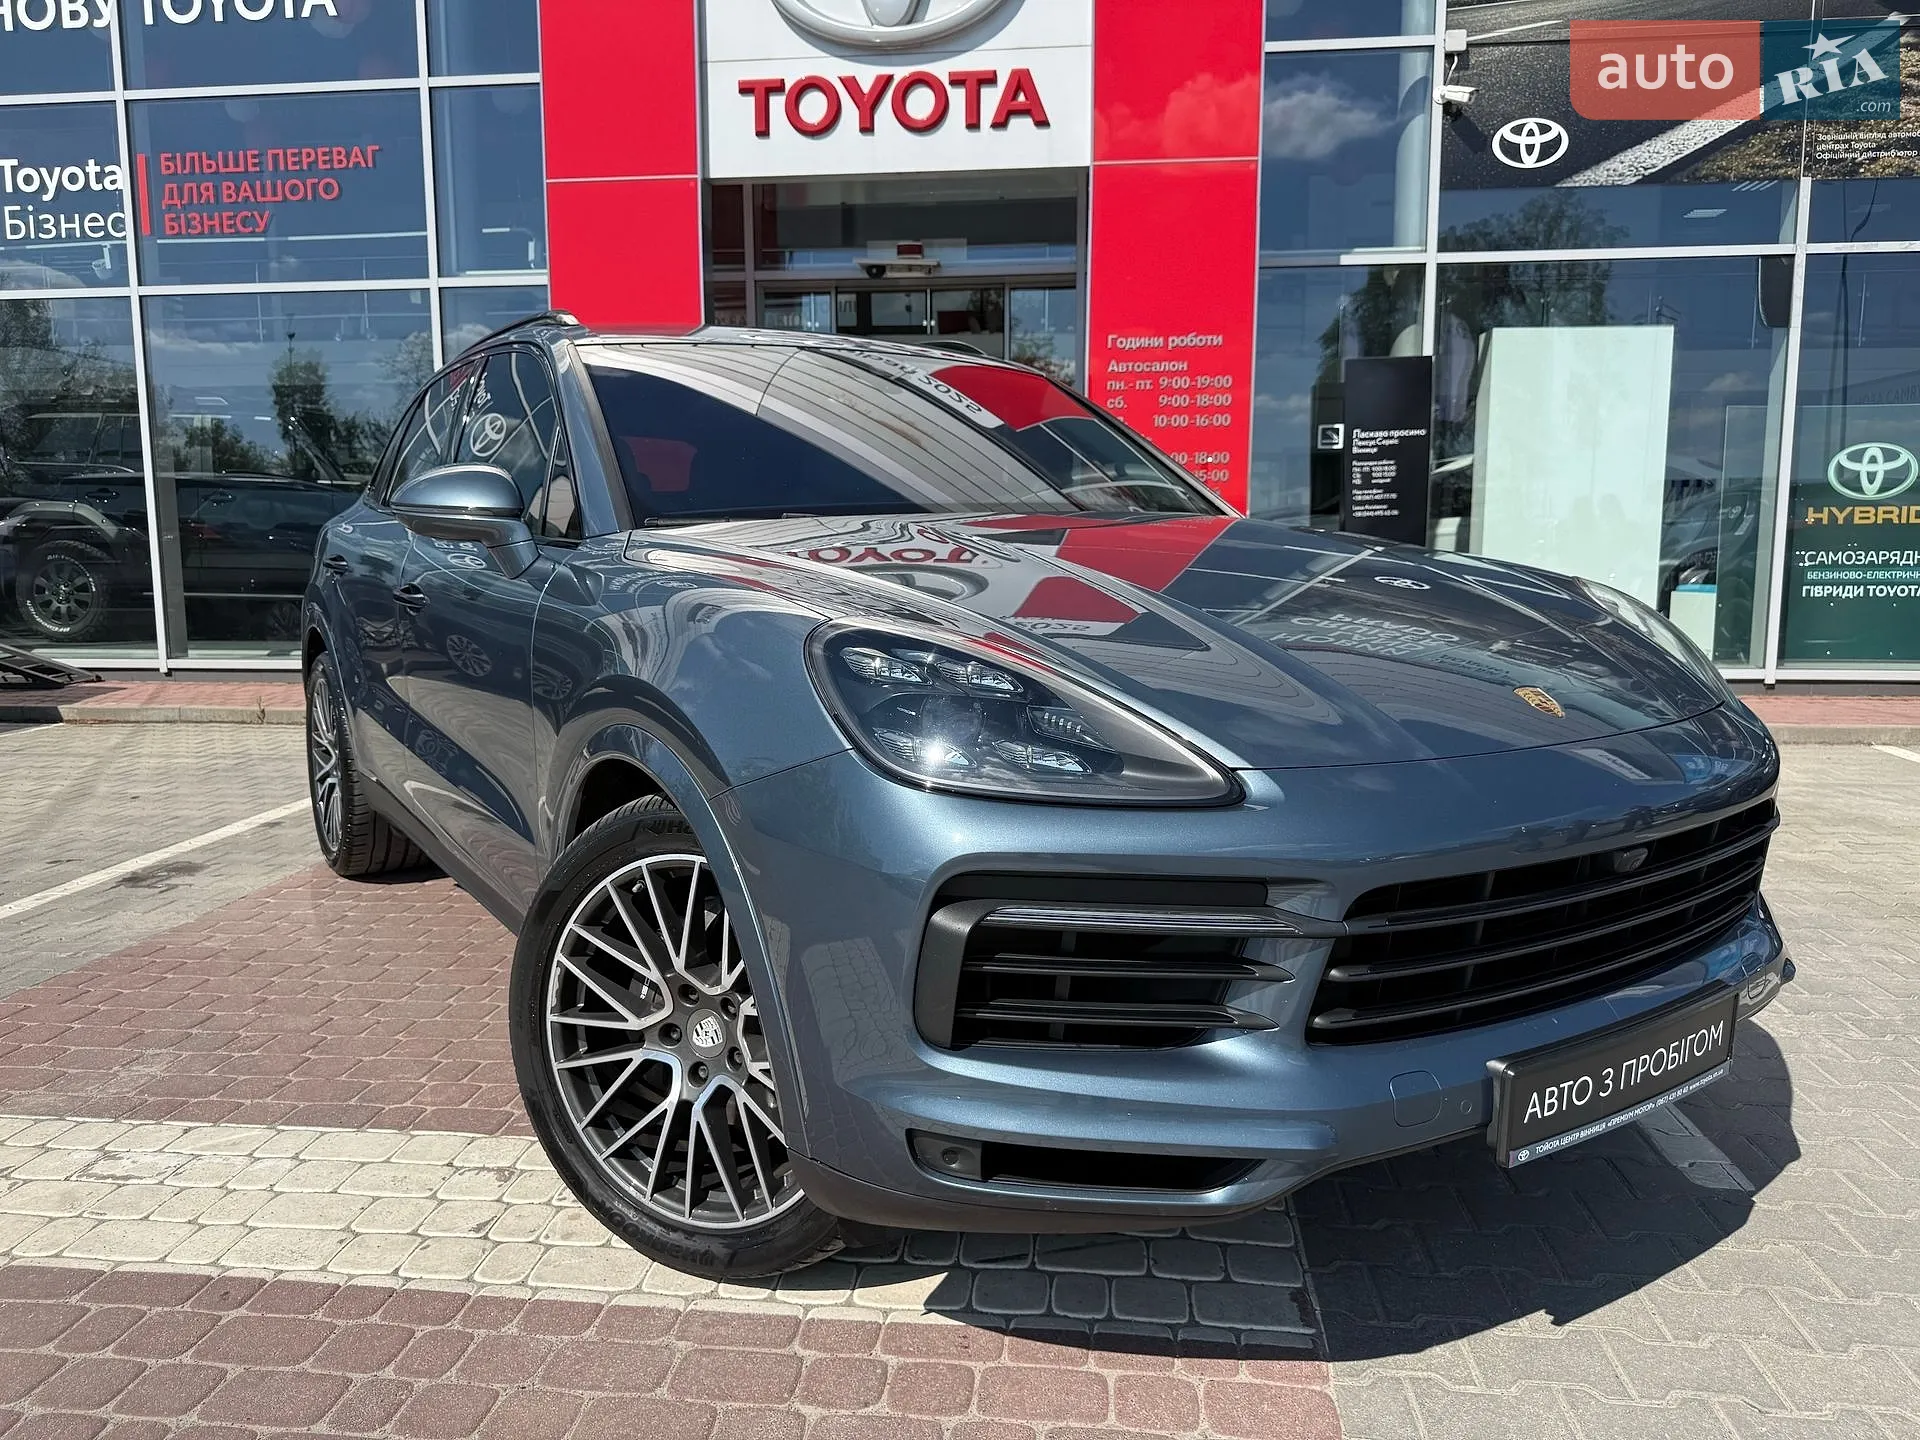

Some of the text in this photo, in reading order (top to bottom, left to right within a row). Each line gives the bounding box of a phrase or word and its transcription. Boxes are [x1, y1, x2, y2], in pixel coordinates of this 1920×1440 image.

[738, 68, 1050, 138] TOYOTA
[1816, 150, 1860, 160] Офіційний
[1851, 140, 1877, 150] Toyota
[160, 145, 380, 175] БІЛЬШЕ ПЕРЕВАГ
[0, 158, 123, 202] Toyota
[161, 177, 339, 209] ДЛЯ ВАШОГО
[4, 204, 126, 240] Бізнес
[164, 209, 270, 235] БІЗНЕСУ
[1107, 333, 1223, 350] Години роботи
[1107, 359, 1188, 373] Автосалон
[1106, 396, 1128, 409] сб.
[1806, 505, 1920, 525] HYBRID
[1523, 1075, 1593, 1124] АВТО
[1620, 1019, 1724, 1090] ПРОБІГОМ
[1536, 1139, 1560, 1154] ТОЙОТА
[1560, 1131, 1580, 1147] ЦЕНТР
